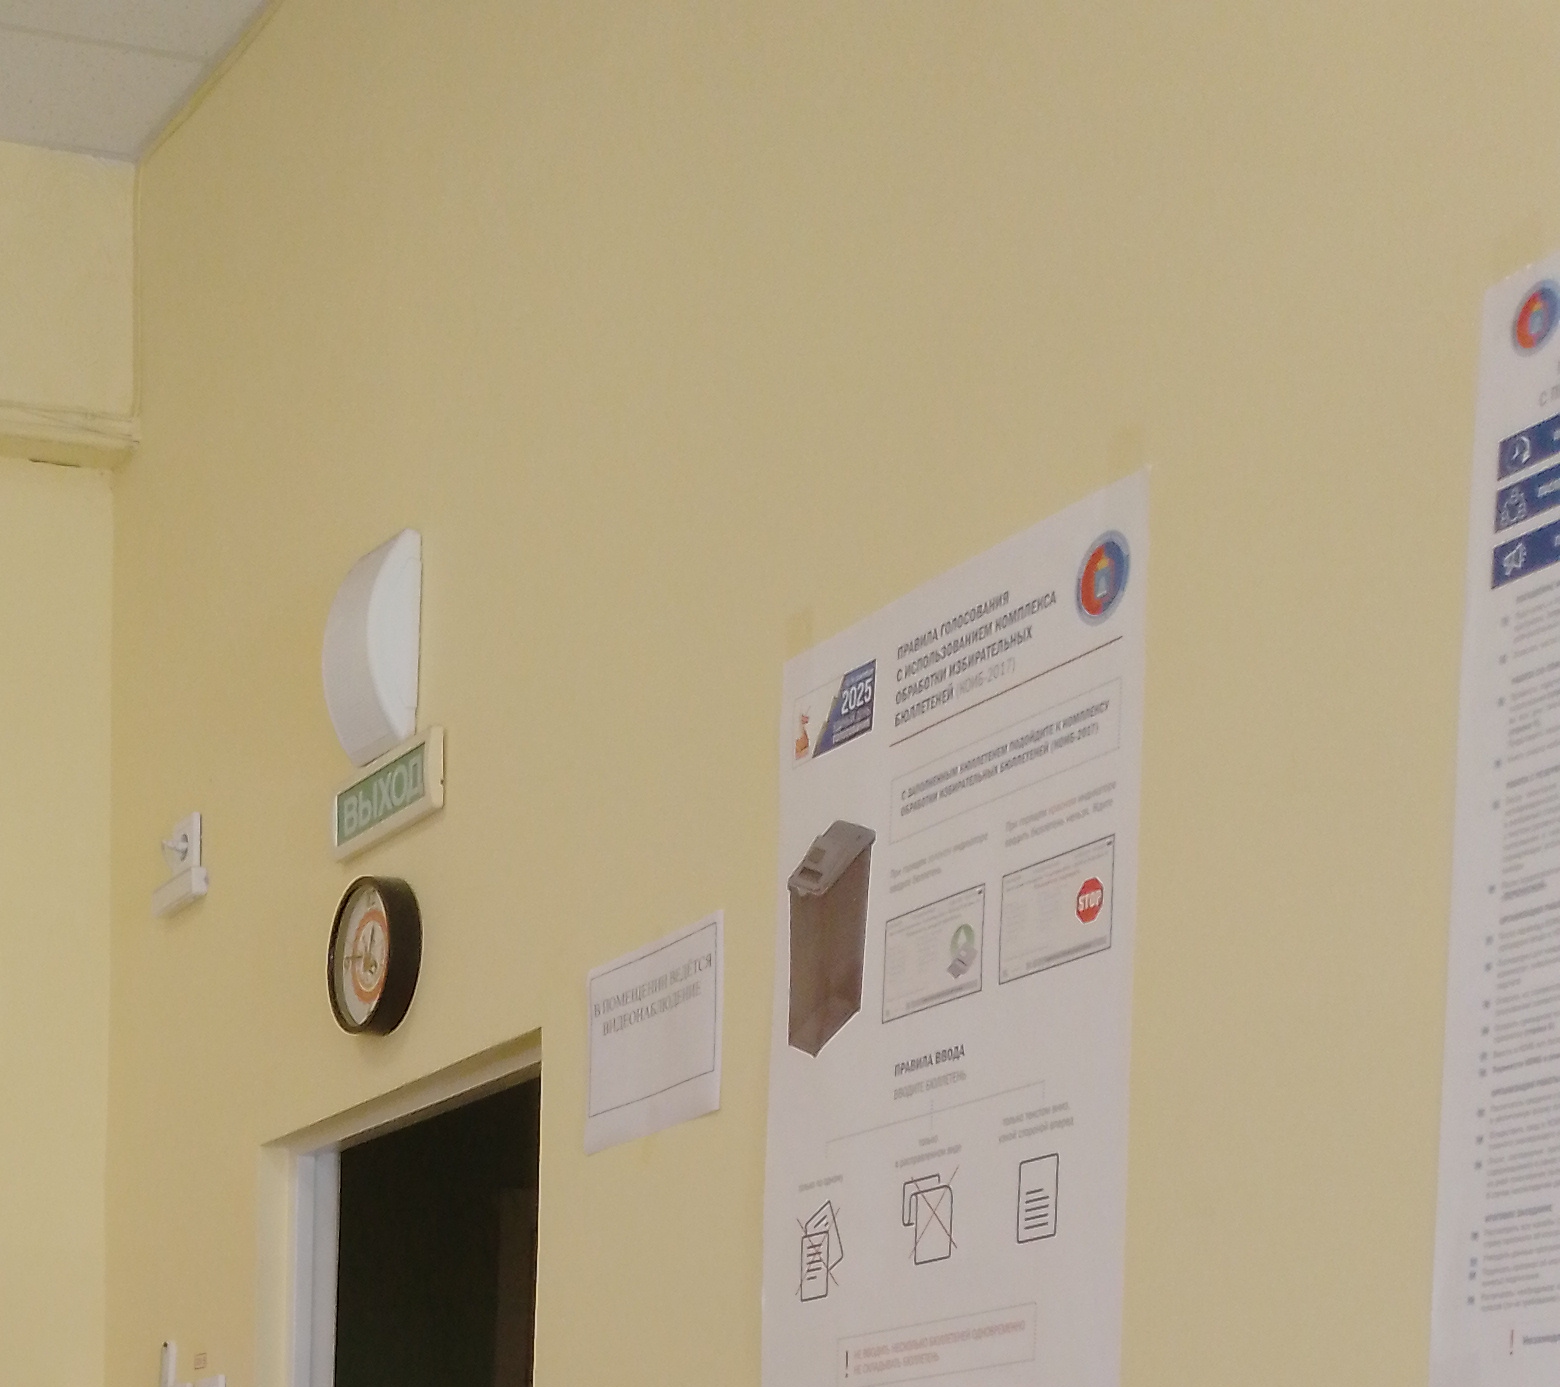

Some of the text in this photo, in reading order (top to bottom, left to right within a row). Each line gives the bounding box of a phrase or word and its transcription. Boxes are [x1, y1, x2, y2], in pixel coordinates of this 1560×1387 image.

[896, 668, 903, 682] С
[904, 621, 993, 680] ИСПОЛЬЗОВАНИЕМ
[995, 590, 1057, 632] КОМПЛЕКСА
[897, 590, 1010, 660] ПРАВИЛА ГОЛОСОВАНИЯ
[895, 668, 947, 705] ОБРАБОТКИ
[948, 625, 1033, 678] ИЗБИРАТЕЛЬНЫХ
[841, 677, 874, 715] 2025
[894, 682, 954, 727] БЮЛЛЕТЕНЕЙ
[342, 754, 424, 836] ВЫХОД
[1077, 889, 1103, 913] STOP
[593, 1003, 601, 1019] В
[602, 973, 668, 1013] ПОМЕЩЕНИИ
[602, 980, 702, 1036] ВИДЕОНАБЛЮДЕНИЕ
[894, 1043, 966, 1078] ПРАВИЛА ВВОДА
